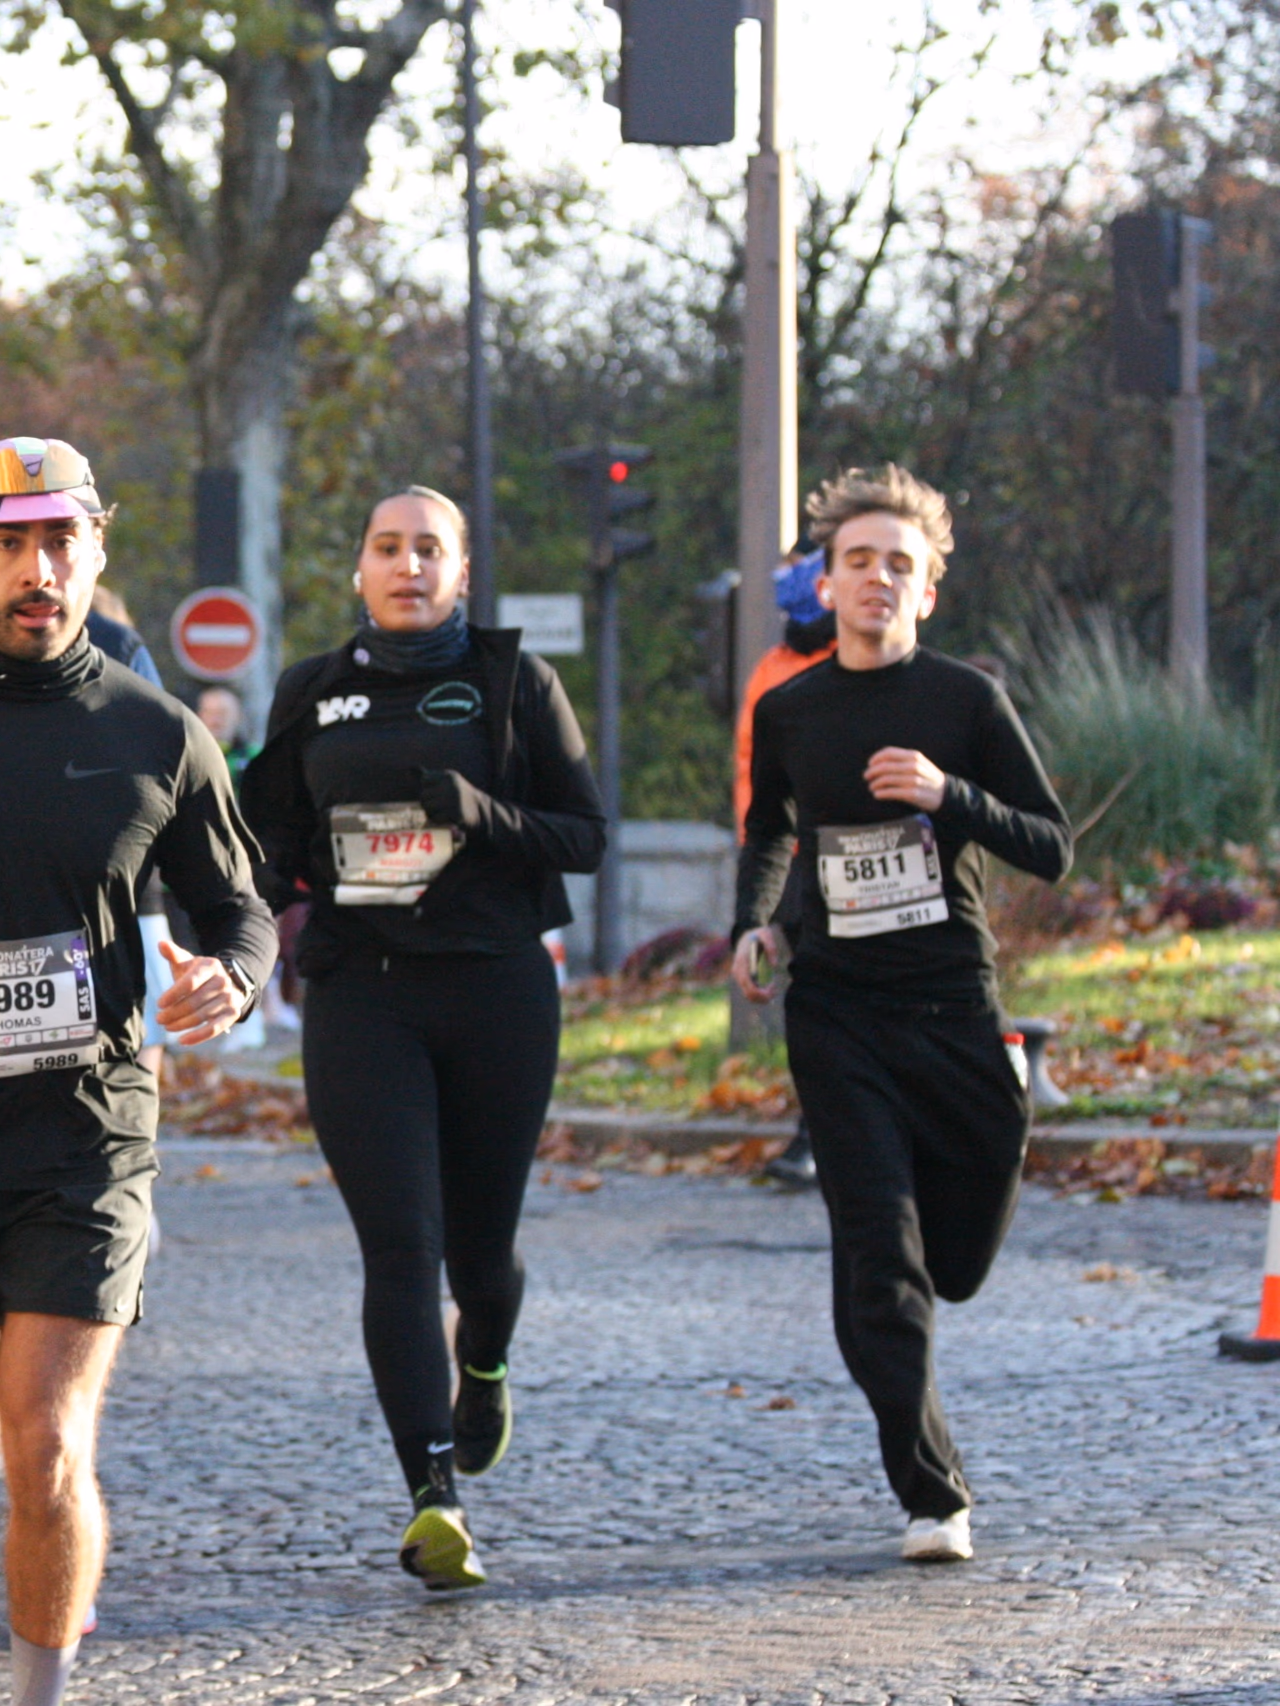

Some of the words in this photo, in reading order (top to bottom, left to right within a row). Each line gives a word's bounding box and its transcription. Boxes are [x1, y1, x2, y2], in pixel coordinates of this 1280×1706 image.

[365, 831, 434, 854] 7974
[844, 853, 906, 882] 5811
[34, 1053, 79, 1071] 5989
